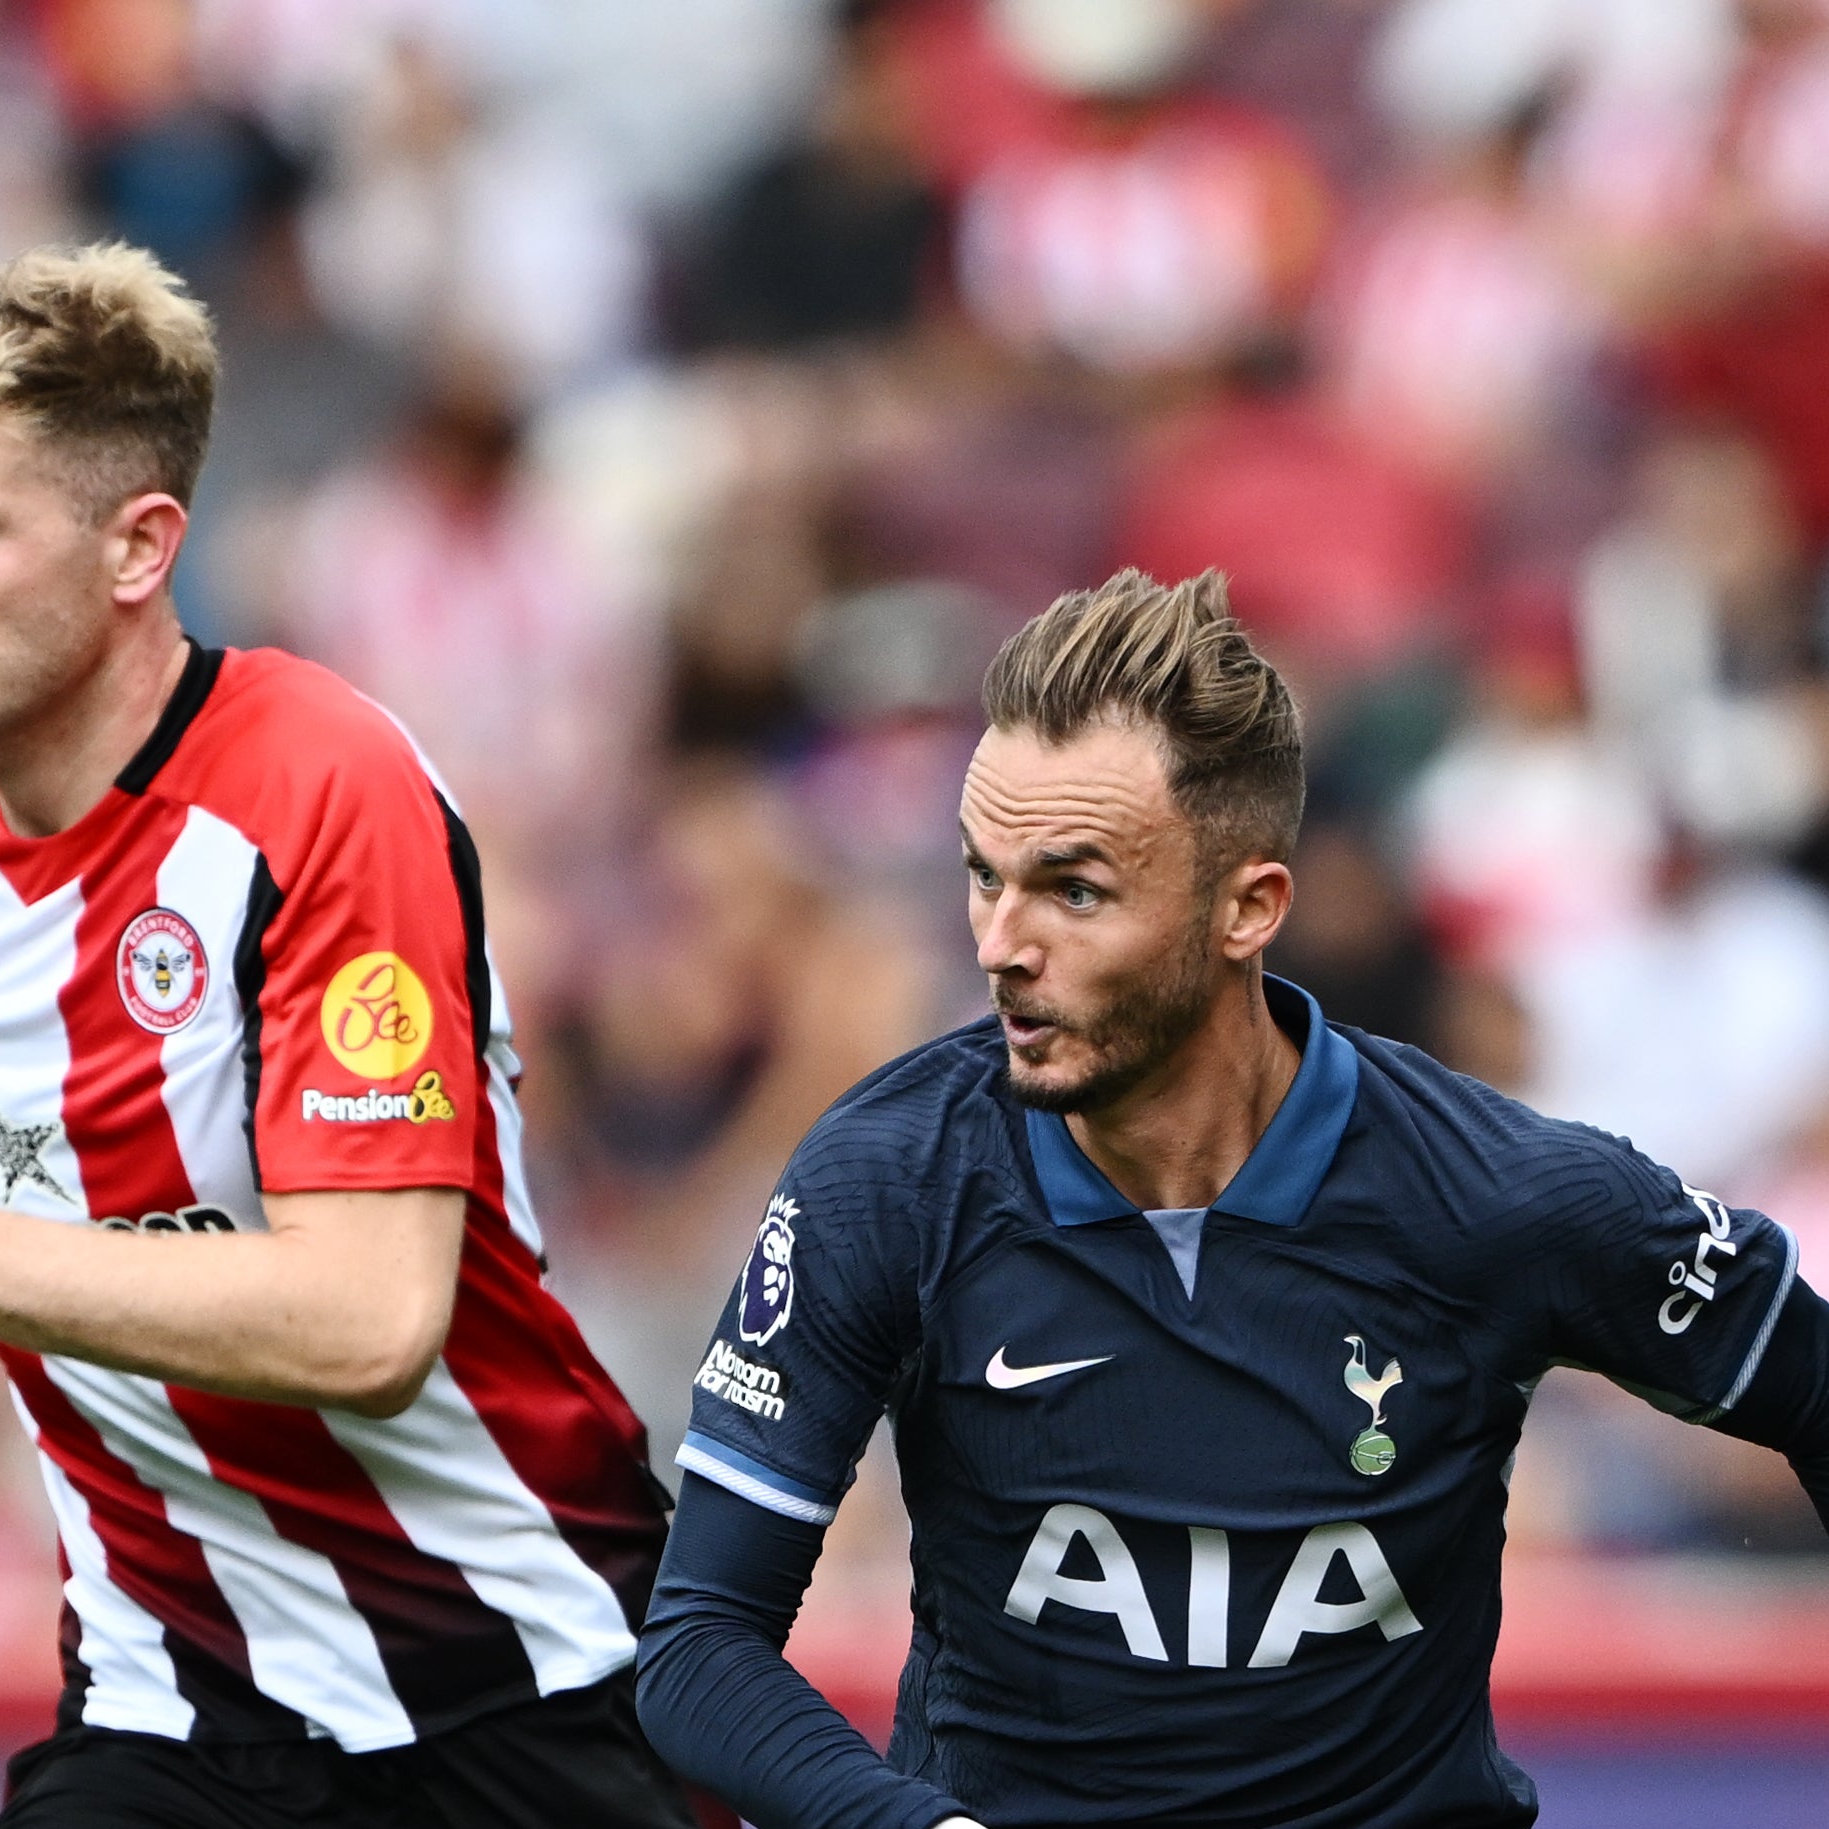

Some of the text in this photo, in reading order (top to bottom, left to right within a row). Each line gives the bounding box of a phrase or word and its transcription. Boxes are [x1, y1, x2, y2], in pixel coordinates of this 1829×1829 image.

[127, 916, 195, 948] BRENTFORD
[705, 1339, 737, 1376] No
[1003, 1502, 1425, 1669] AIA
